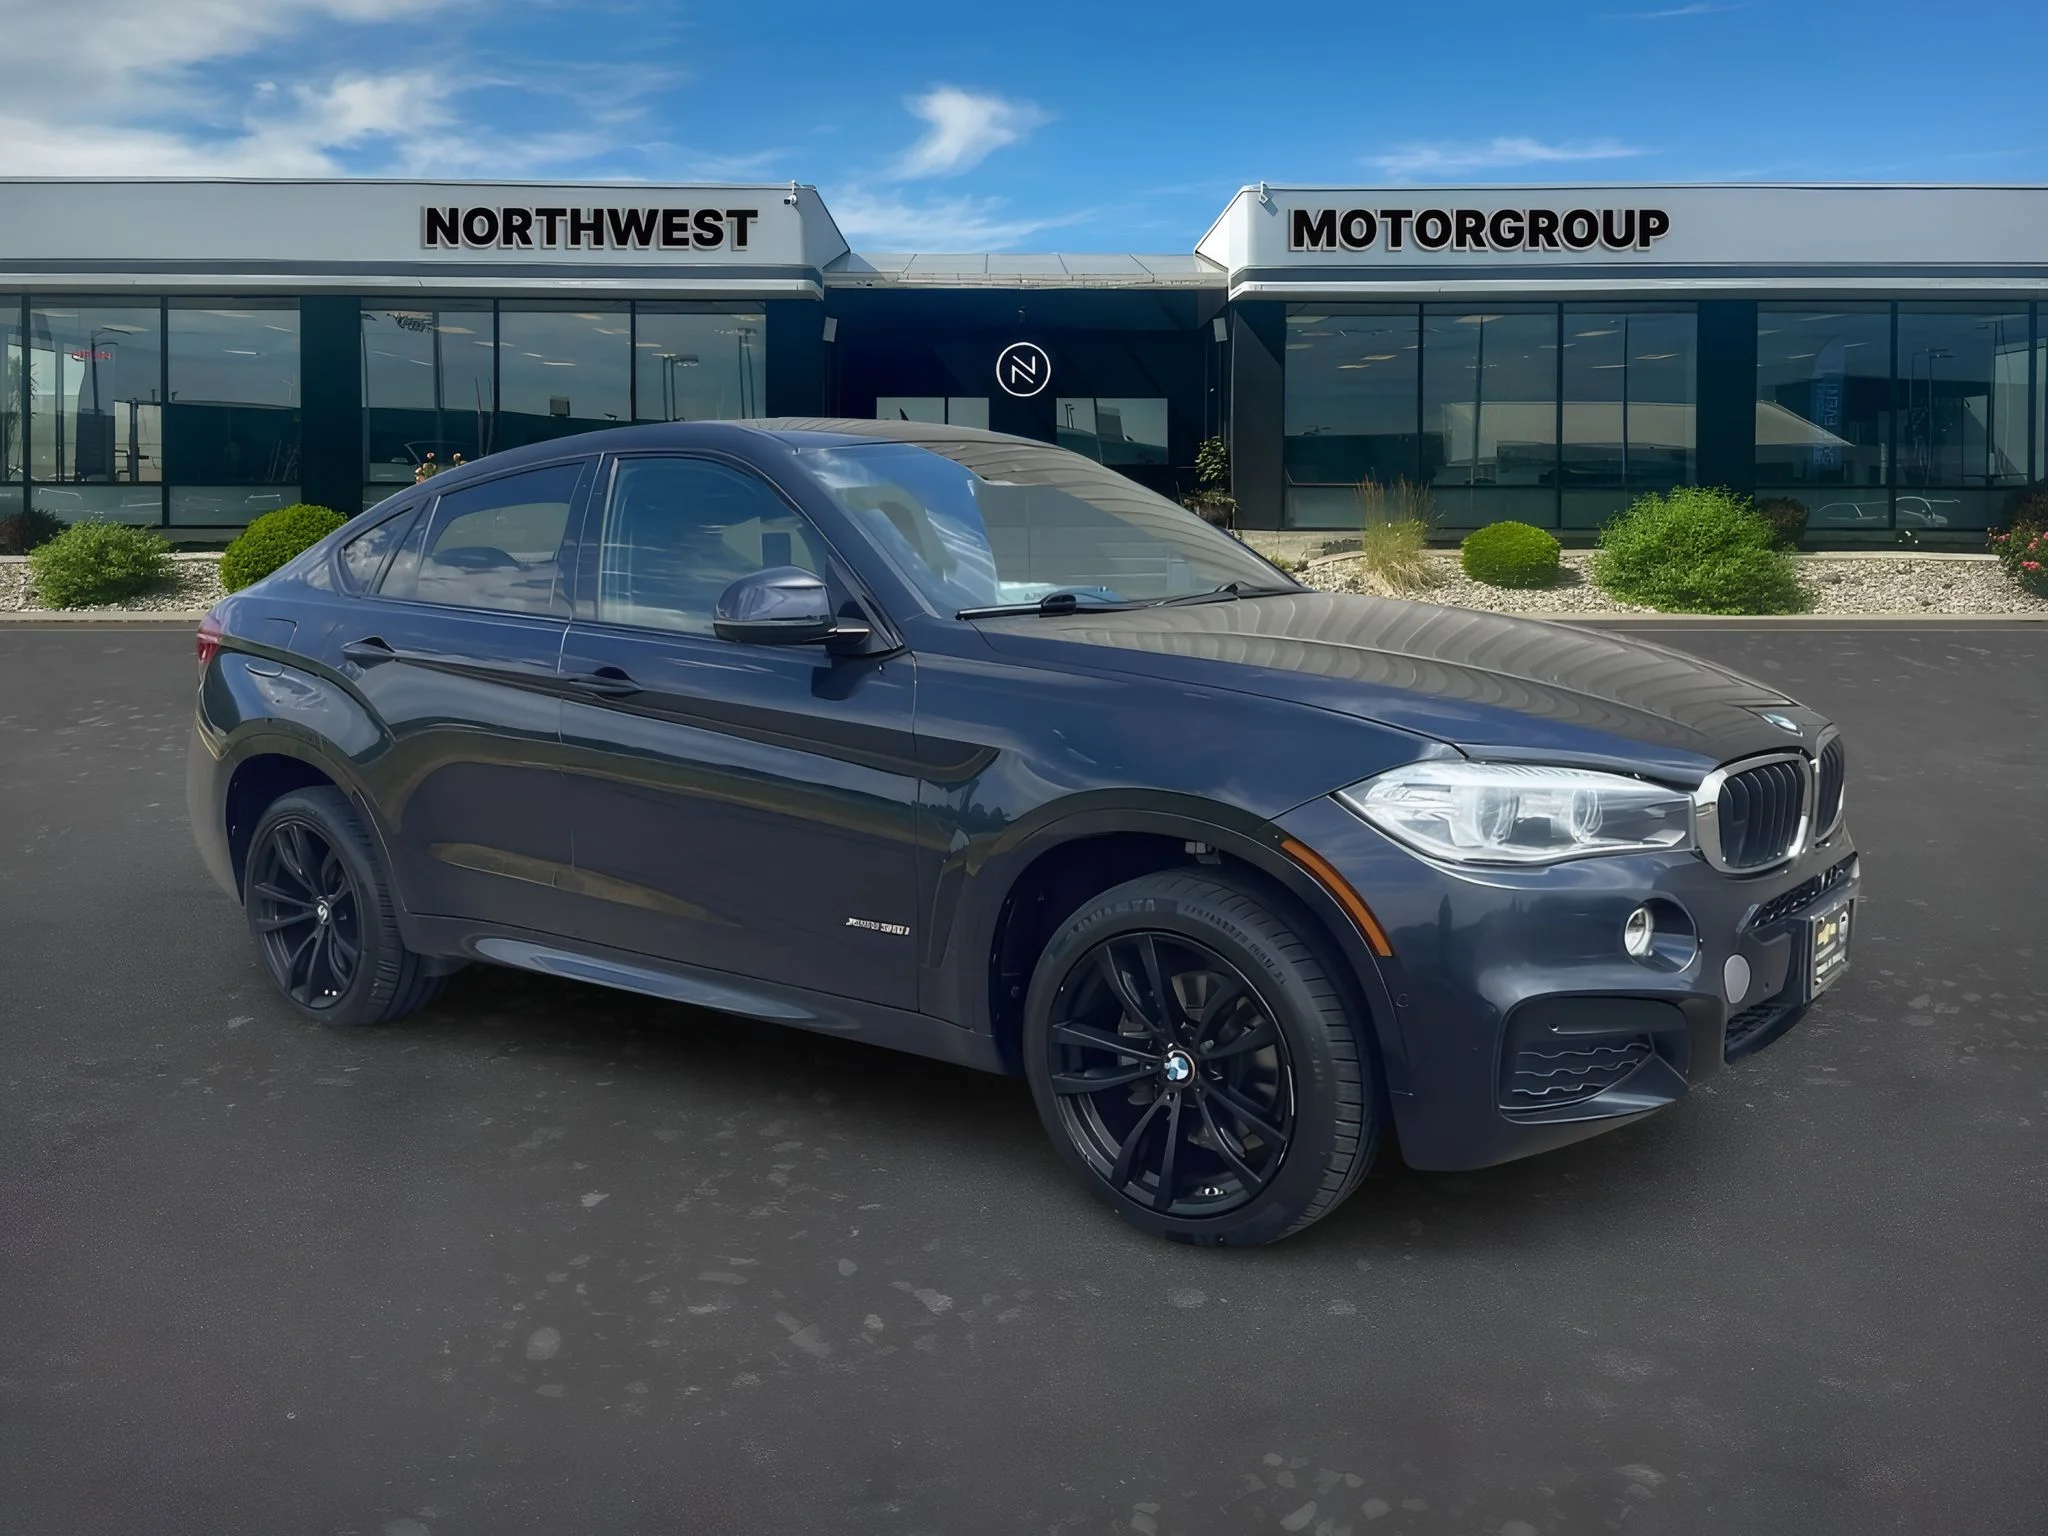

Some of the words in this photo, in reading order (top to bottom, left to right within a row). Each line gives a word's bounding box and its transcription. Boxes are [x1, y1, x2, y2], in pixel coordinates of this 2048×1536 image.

[425, 206, 759, 249] NORTHWEST
[1291, 208, 1670, 252] MOTORGROUP
[1011, 355, 1036, 384] N
